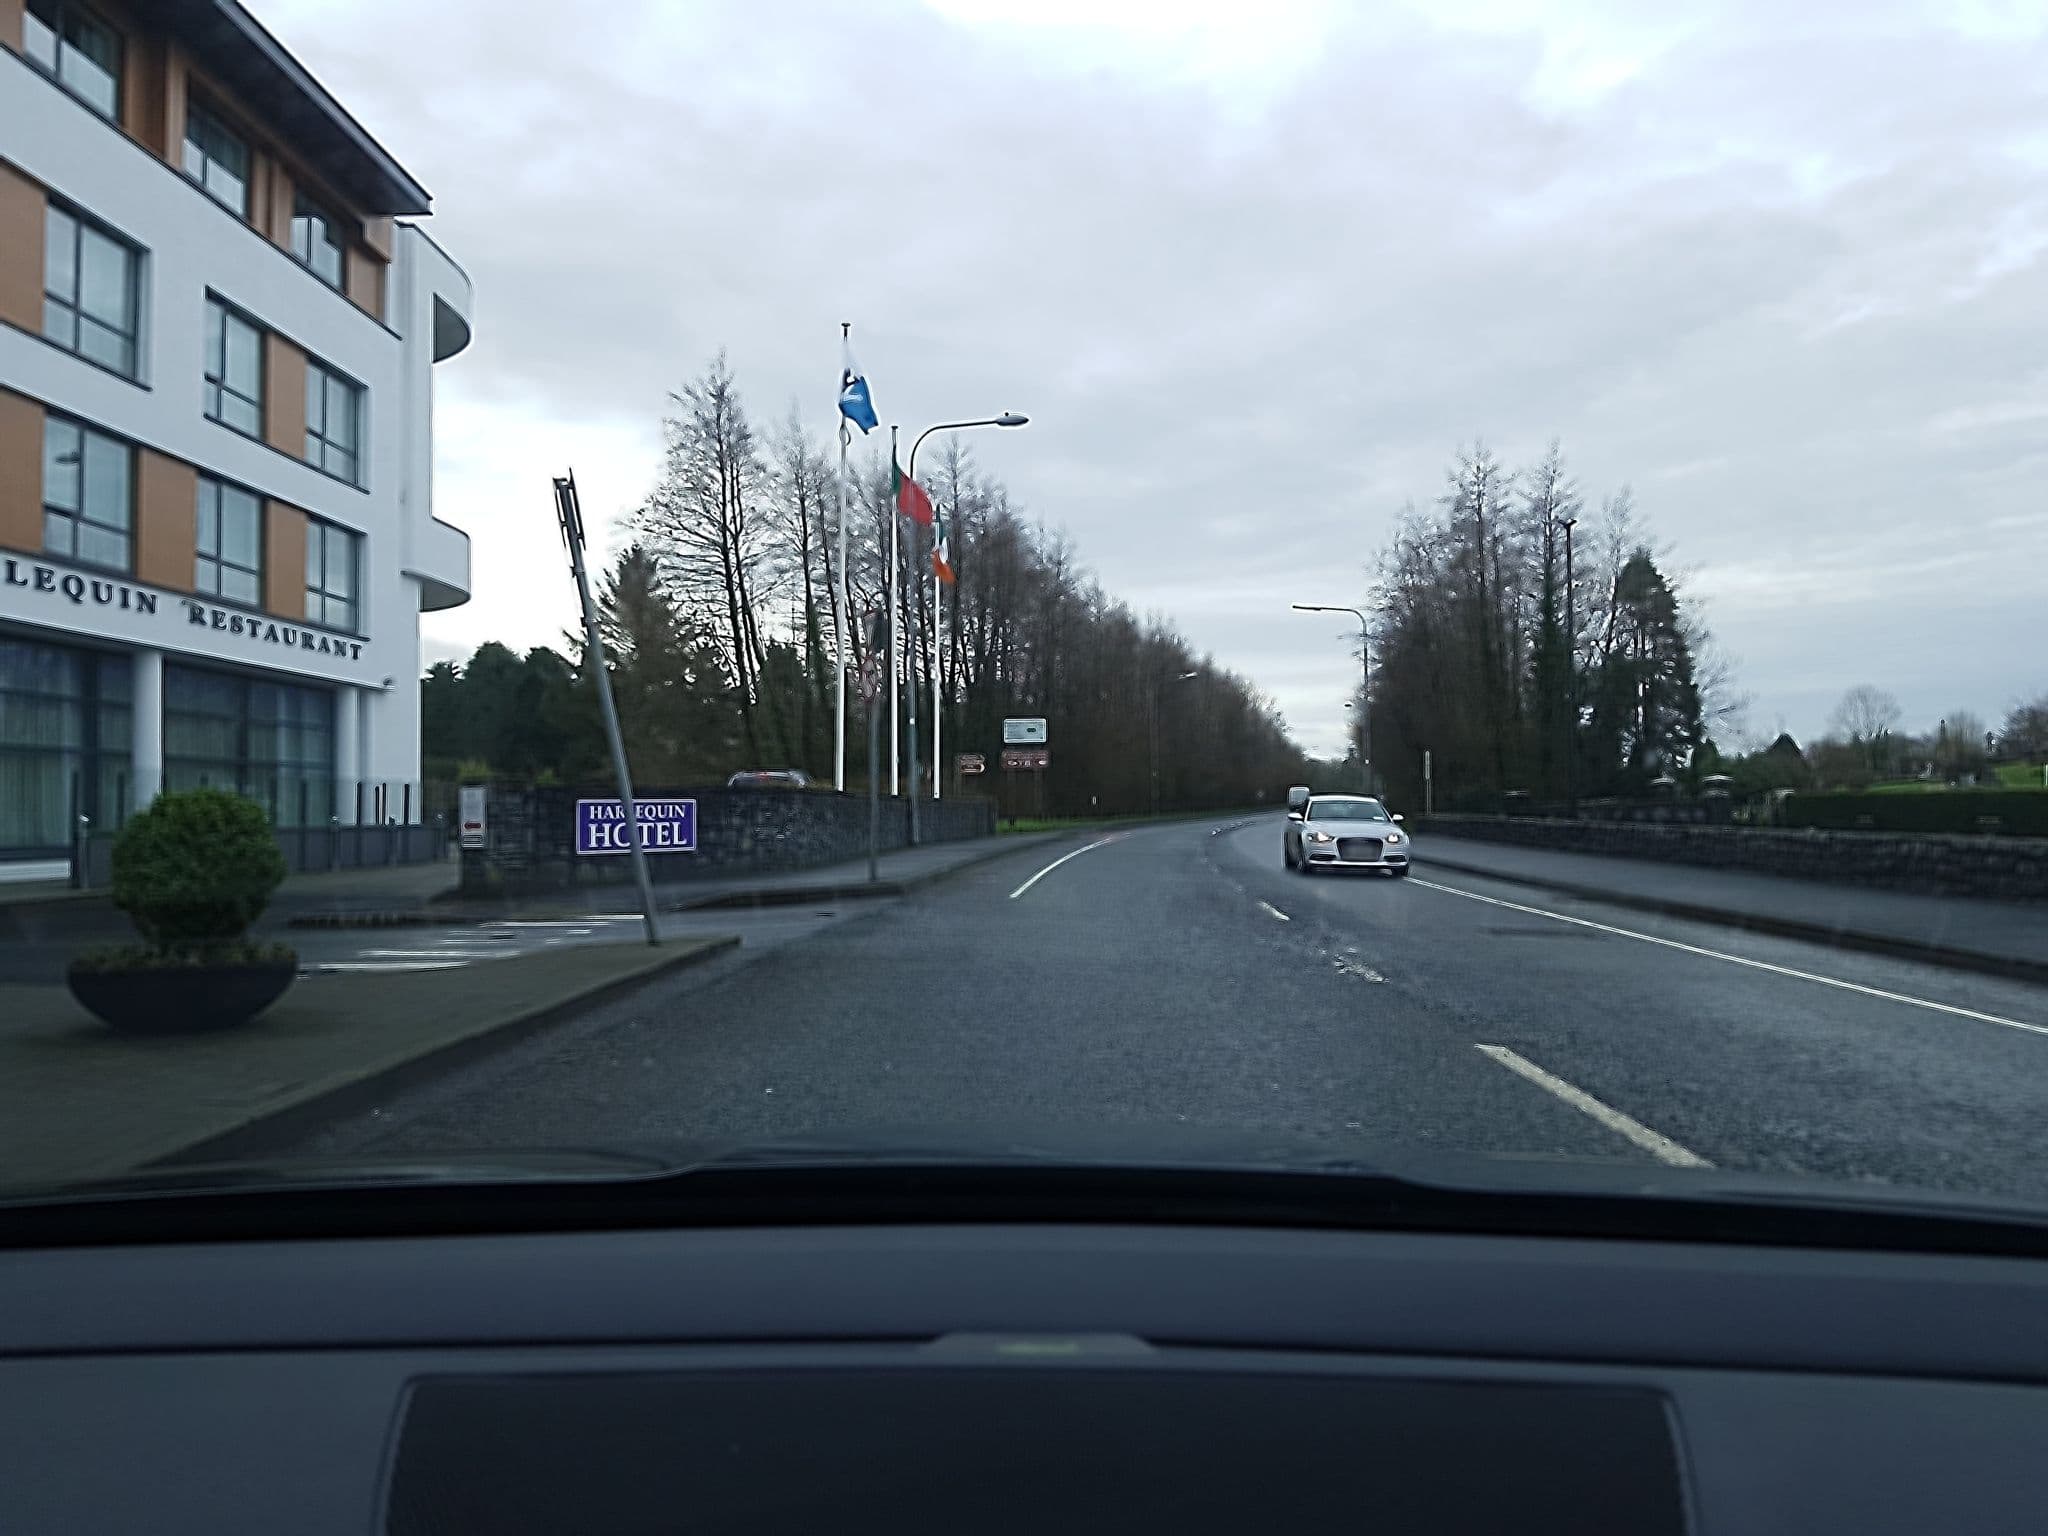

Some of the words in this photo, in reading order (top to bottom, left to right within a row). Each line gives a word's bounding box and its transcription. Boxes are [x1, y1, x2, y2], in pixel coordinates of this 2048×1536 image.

[6, 559, 158, 614] LEQUIN
[181, 600, 363, 661] RESTAURANT
[589, 804, 686, 821] HAREQUIN
